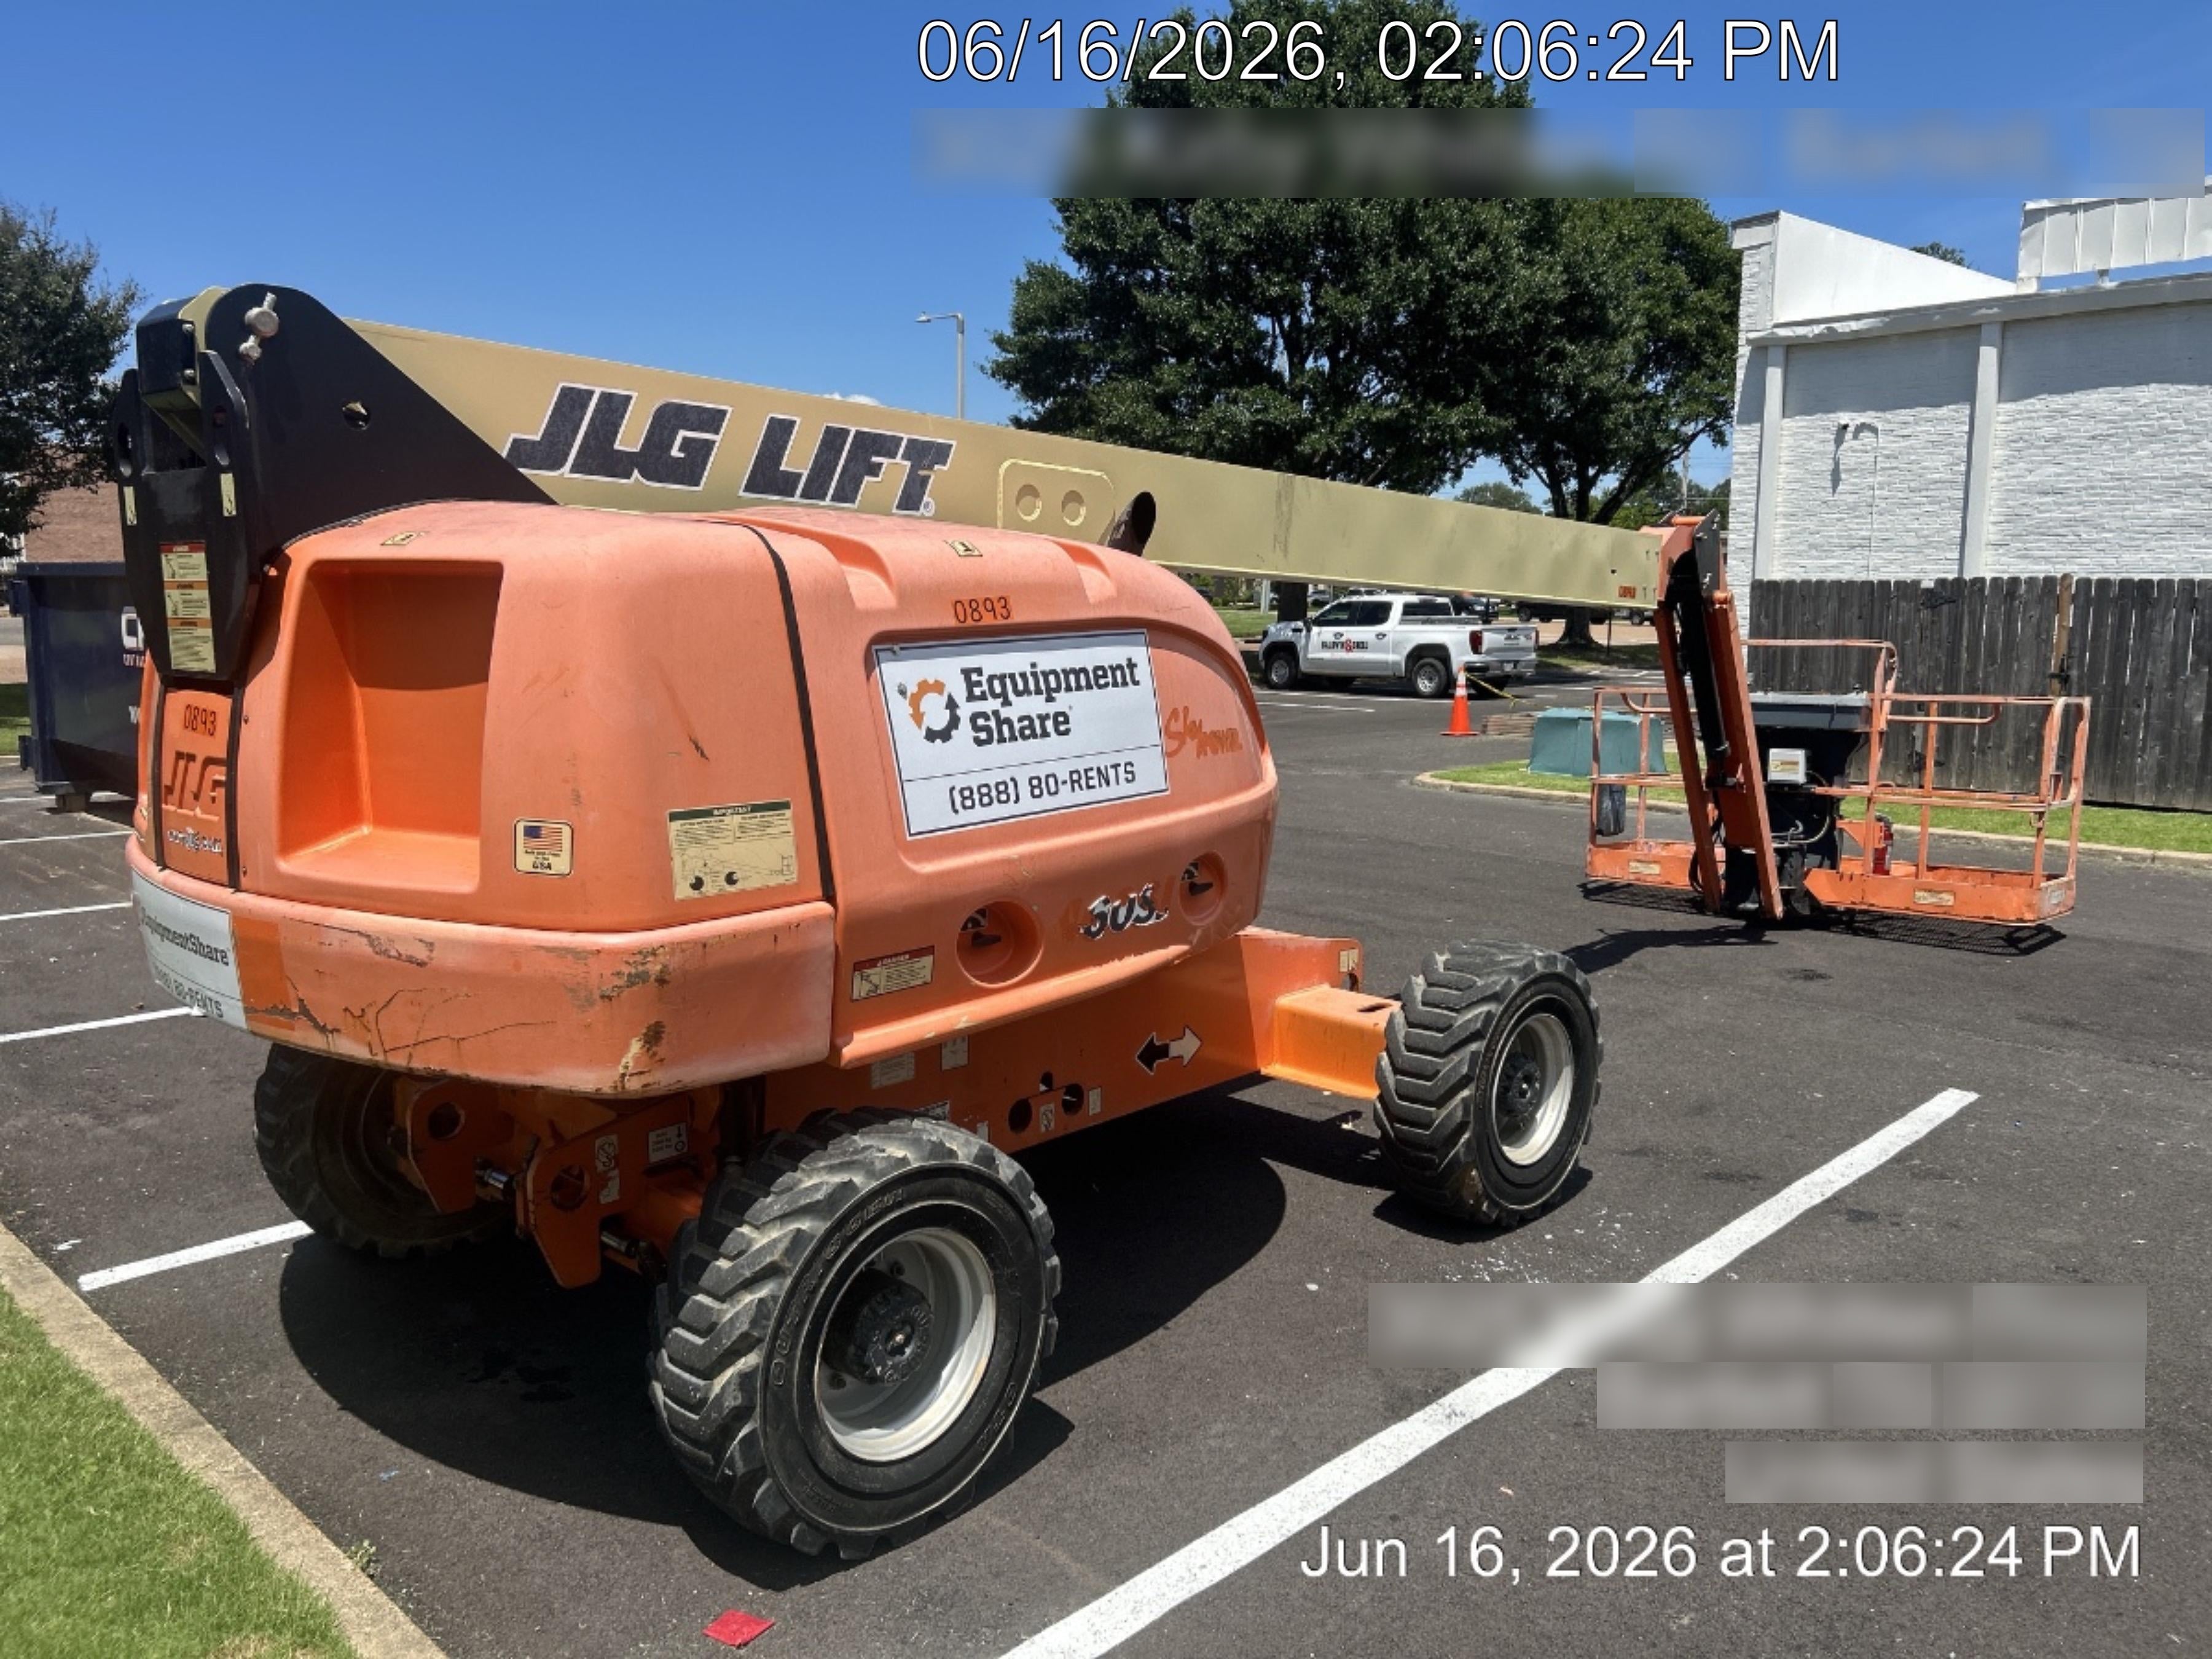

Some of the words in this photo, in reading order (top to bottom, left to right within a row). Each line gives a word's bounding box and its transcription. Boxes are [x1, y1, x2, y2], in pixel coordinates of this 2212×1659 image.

[501, 382, 732, 490] JLG
[954, 596, 1011, 624] 0893
[960, 657, 1141, 707] Equipment
[184, 704, 217, 736] 0893
[969, 708, 1073, 747] Share
[949, 777, 1020, 815] (888)
[1028, 761, 1136, 800] 80-RENTS
